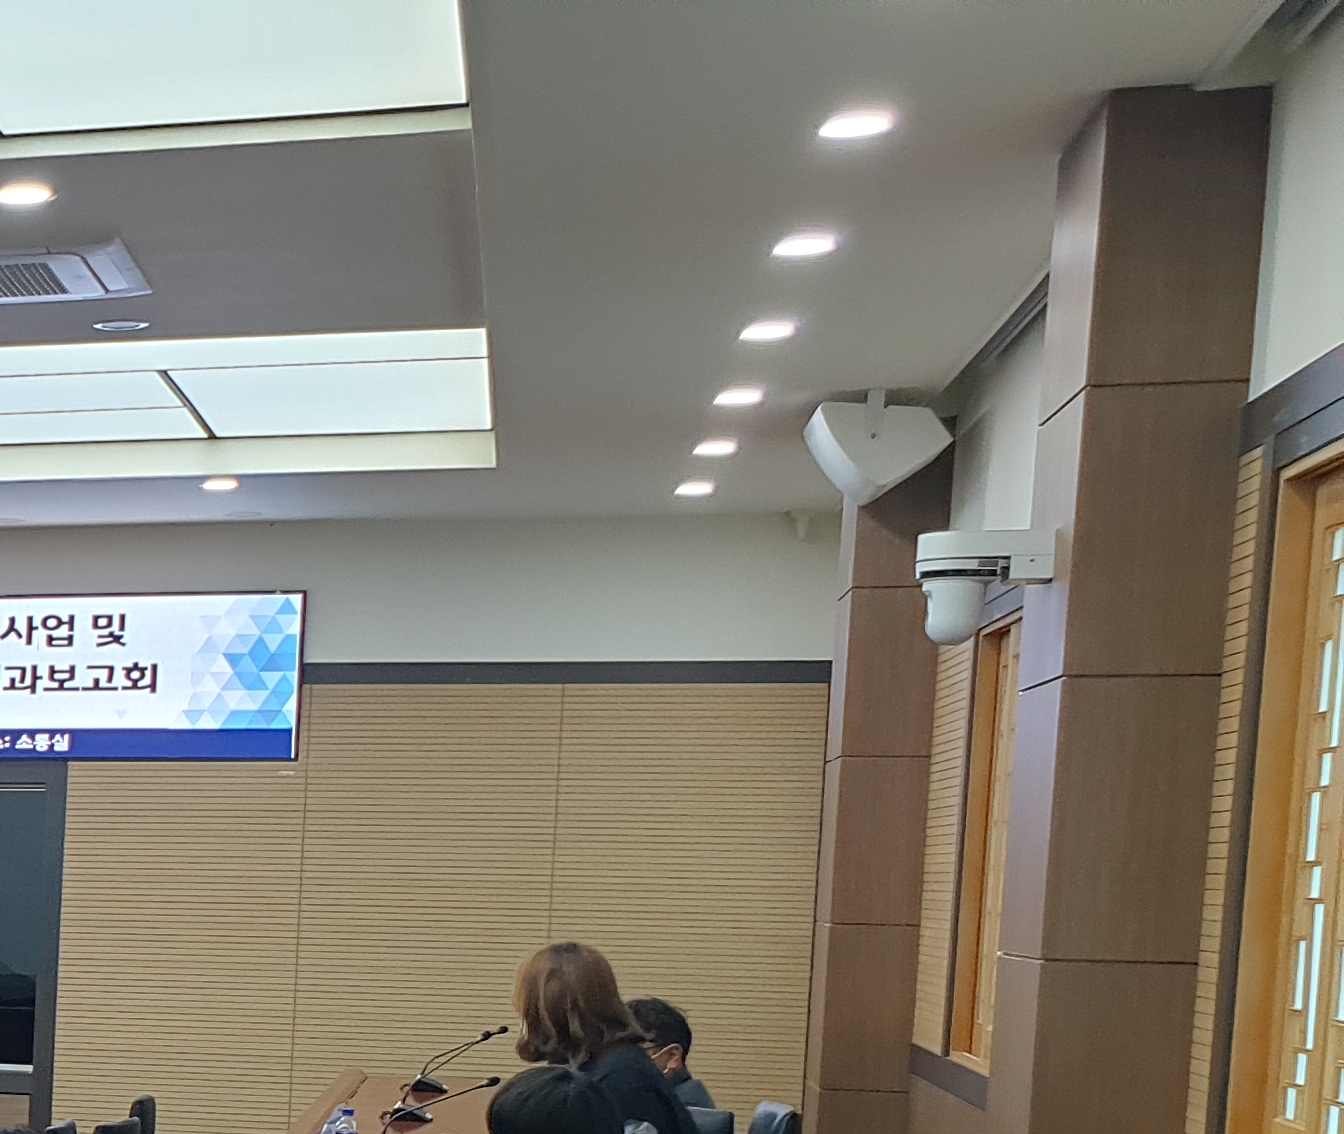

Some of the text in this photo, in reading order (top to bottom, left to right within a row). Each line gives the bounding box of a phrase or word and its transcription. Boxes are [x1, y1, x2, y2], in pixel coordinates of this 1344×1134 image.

[0, 614, 75, 647] 사업
[91, 613, 127, 647] 및
[14, 733, 70, 751] 소통실
